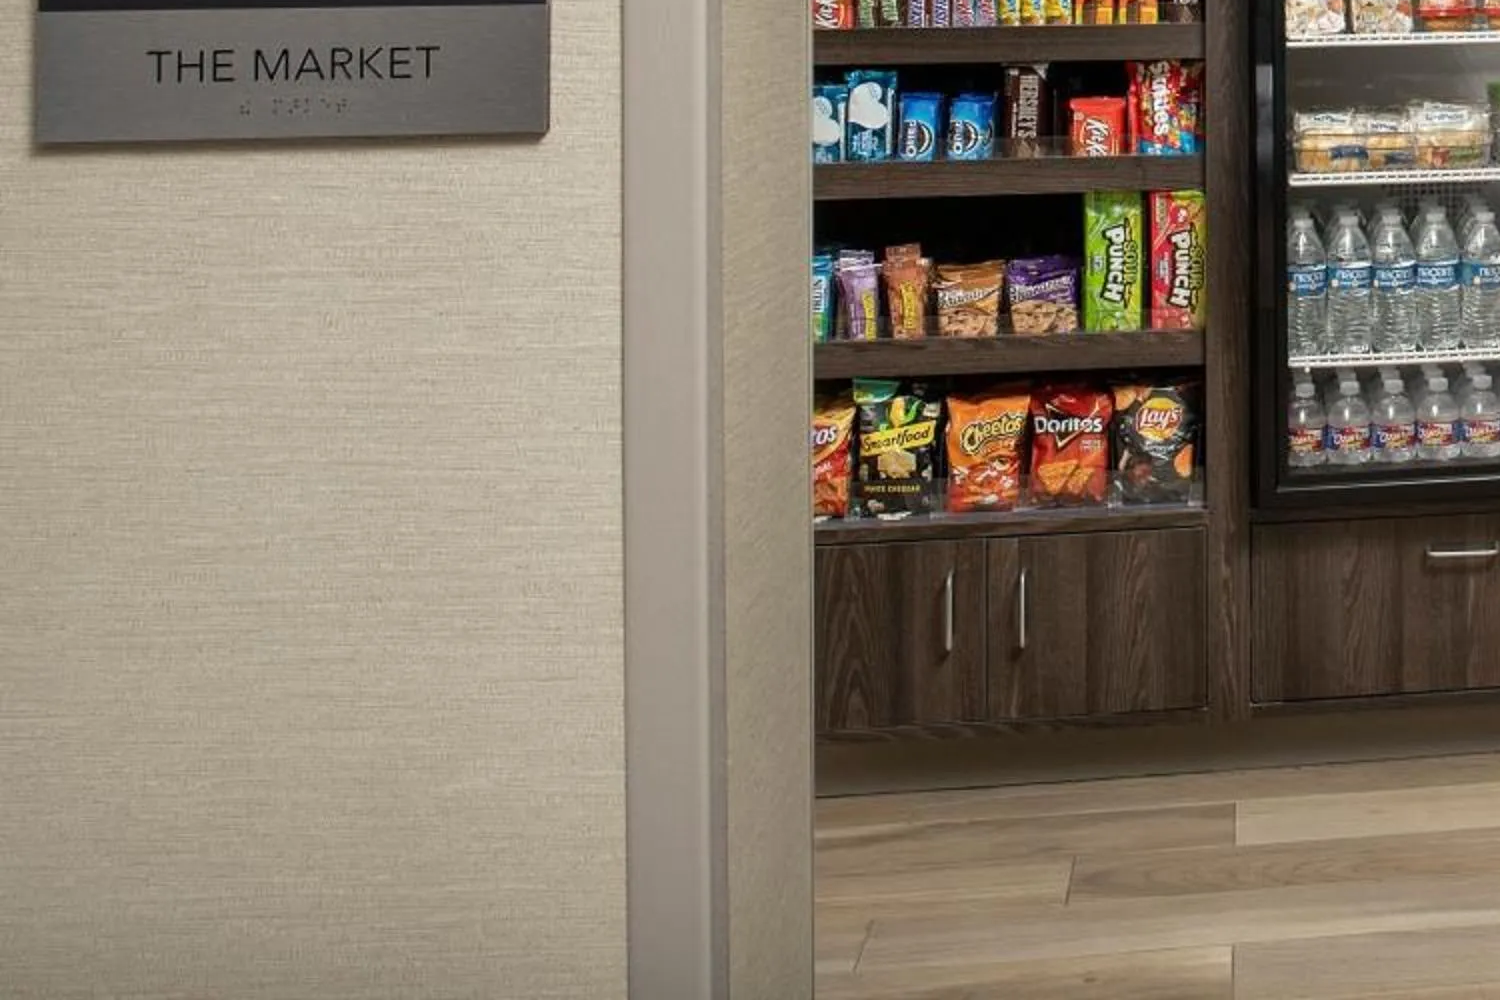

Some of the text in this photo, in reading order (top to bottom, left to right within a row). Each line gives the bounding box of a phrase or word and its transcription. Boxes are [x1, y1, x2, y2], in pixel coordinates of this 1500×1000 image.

[146, 46, 441, 83] THE MARKET
[1103, 225, 1125, 302] PUNCH
[1169, 230, 1191, 308] PUNCH
[961, 417, 1022, 453] Cheetos
[1034, 416, 1103, 433] Doritos
